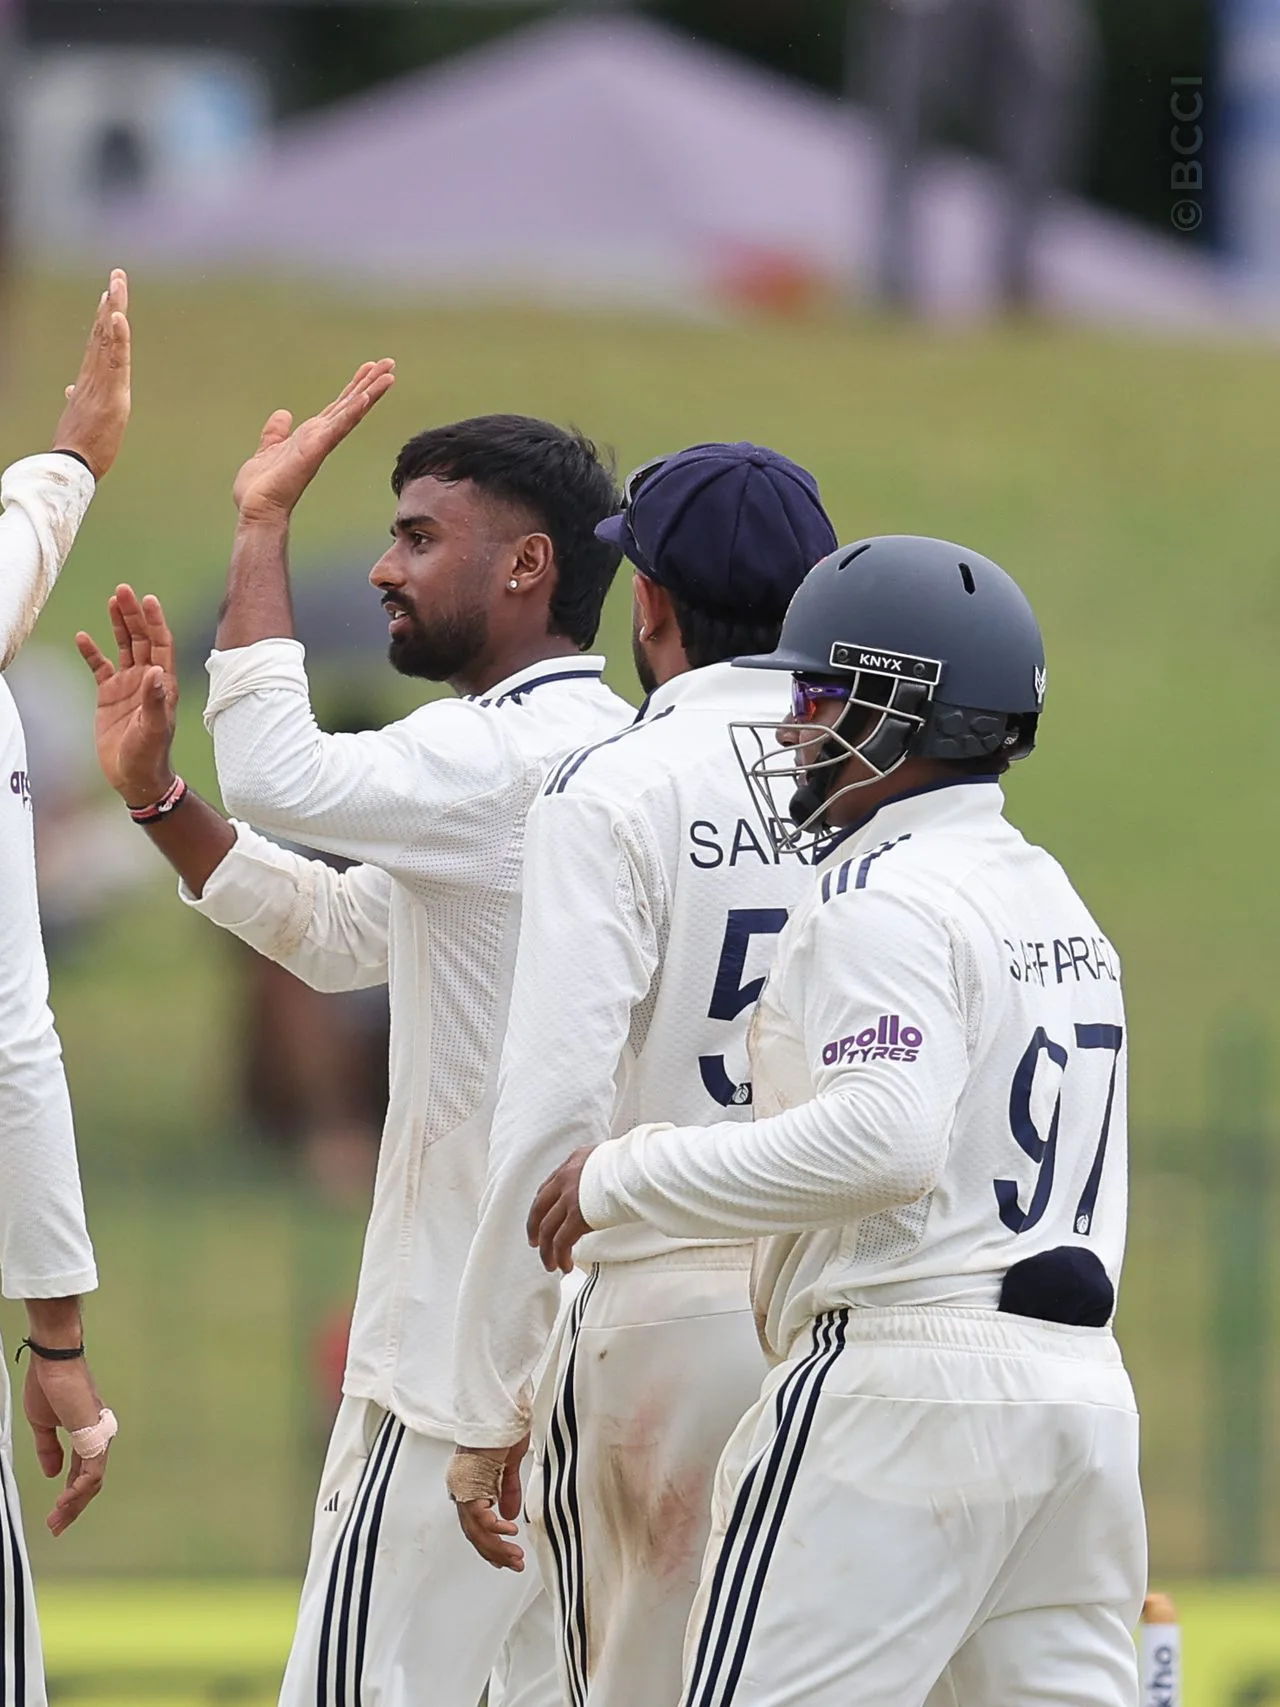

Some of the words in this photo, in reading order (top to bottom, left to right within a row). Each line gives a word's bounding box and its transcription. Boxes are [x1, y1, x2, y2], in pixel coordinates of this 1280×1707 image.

[859, 653, 903, 671] KNYX
[822, 1014, 923, 1066] apollo
[846, 1046, 919, 1064] TYRES
[993, 1023, 1123, 1236] 97
